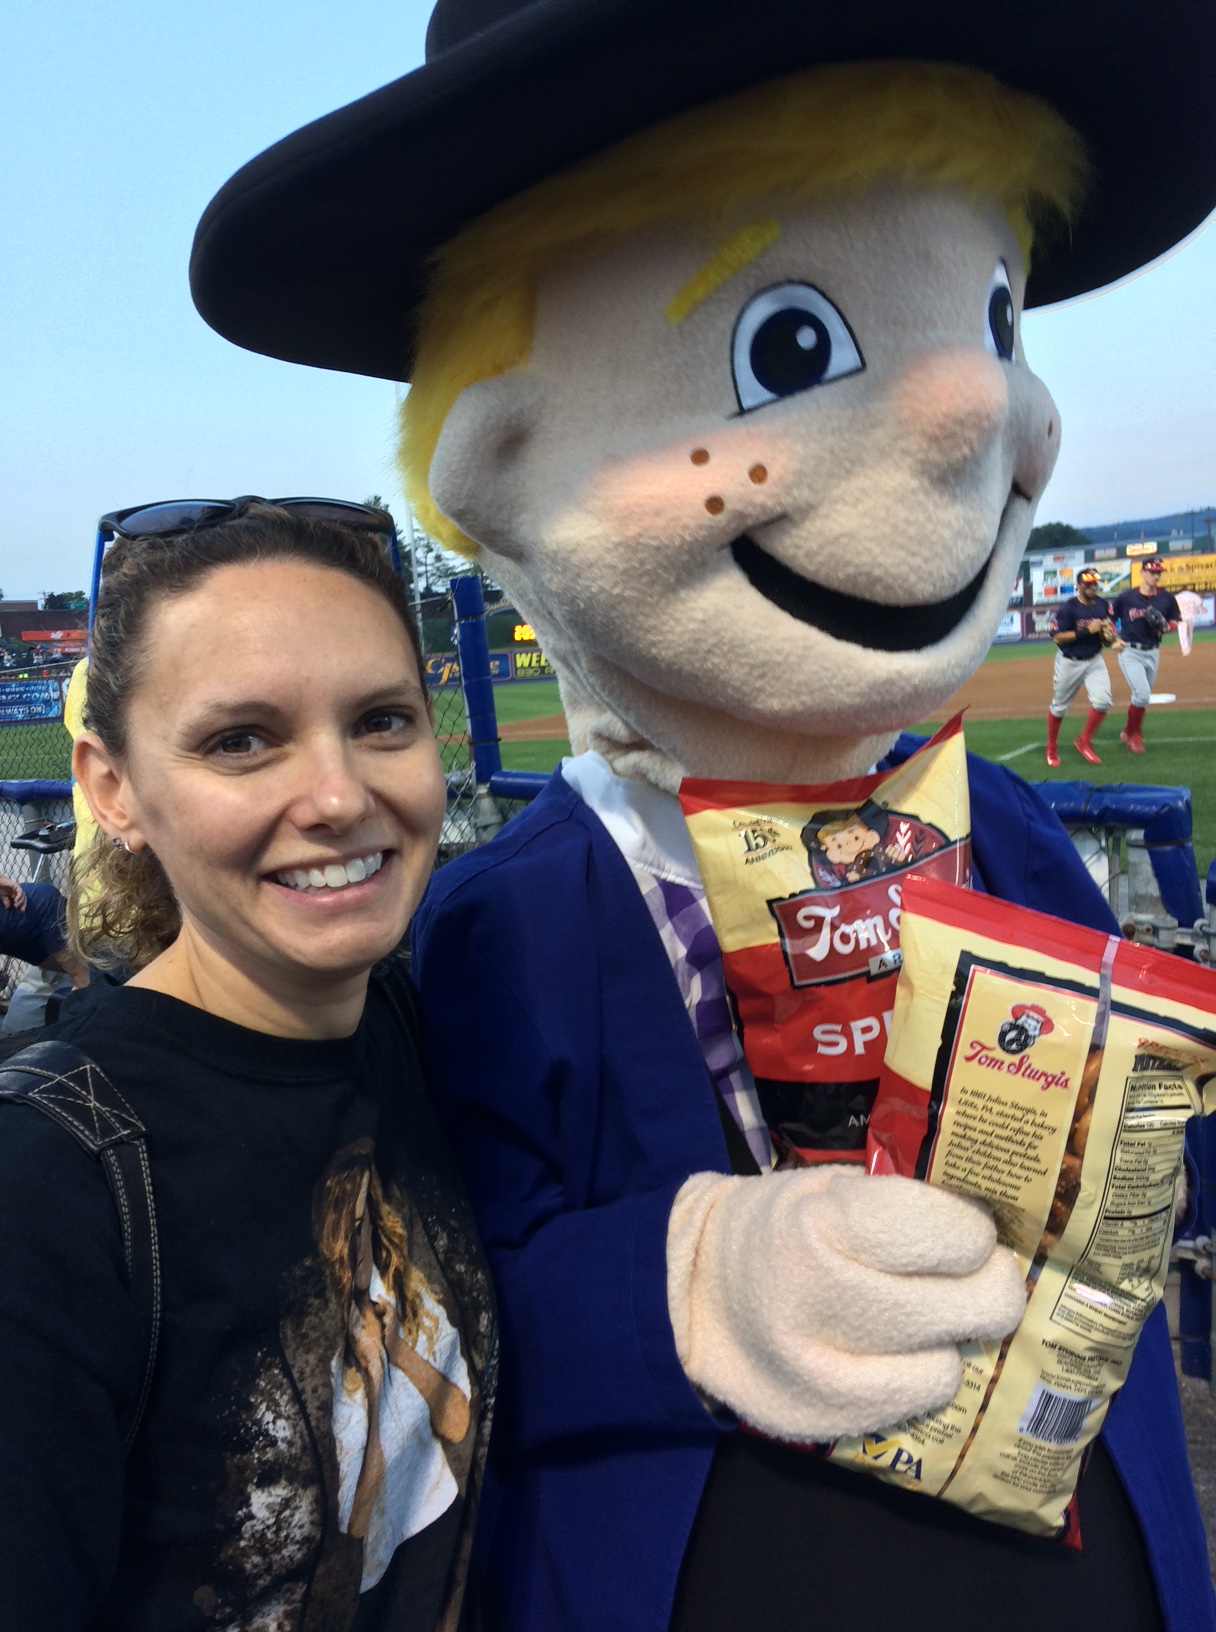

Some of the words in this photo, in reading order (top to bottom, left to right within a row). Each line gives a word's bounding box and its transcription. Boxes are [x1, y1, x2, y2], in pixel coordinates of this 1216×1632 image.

[797, 904, 892, 962] Tom
[964, 1040, 1004, 1071] Tom
[1007, 1053, 1070, 1091] Sturgis
[960, 1086, 968, 1095] In
[986, 1093, 1008, 1107] Julius
[1009, 1100, 1038, 1116] Sturgis,
[1039, 1109, 1048, 1118] in
[1130, 1081, 1156, 1092] Nutrition
[1158, 1081, 1184, 1091] Facts
[956, 1109, 978, 1121] where
[978, 1114, 988, 1124] he
[988, 1118, 1009, 1130] could
[1010, 1123, 1031, 1138] refine
[1031, 1129, 1044, 1141] his
[957, 1098, 979, 1112] Lititz,
[995, 1109, 1024, 1123] started
[1030, 1118, 1058, 1136] bakery
[950, 1130, 978, 1144] making
[979, 1137, 1010, 1154] delicious
[952, 1120, 978, 1133] recipes
[978, 1125, 994, 1137] and
[994, 1131, 1026, 1147] methods
[1025, 1140, 1039, 1151] for
[944, 1160, 961, 1171] take
[962, 1167, 981, 1181] few
[981, 1173, 1022, 1191] wholesome
[945, 1149, 964, 1161] from
[964, 1155, 983, 1167] their
[982, 1159, 1007, 1174] father
[1006, 1167, 1024, 1179] how
[1023, 1174, 1033, 1184] to
[972, 1145, 1002, 1163] children
[1001, 1157, 1019, 1168] also
[1018, 1160, 1049, 1177] learned
[942, 1170, 983, 1191] ingredients,
[984, 1184, 999, 1195] mix
[999, 1189, 1019, 1202] them
[1041, 1338, 1057, 1351] TOM
[972, 1365, 984, 1375] our
[929, 1425, 954, 1439] pretzel
[890, 1447, 922, 1480] PA
